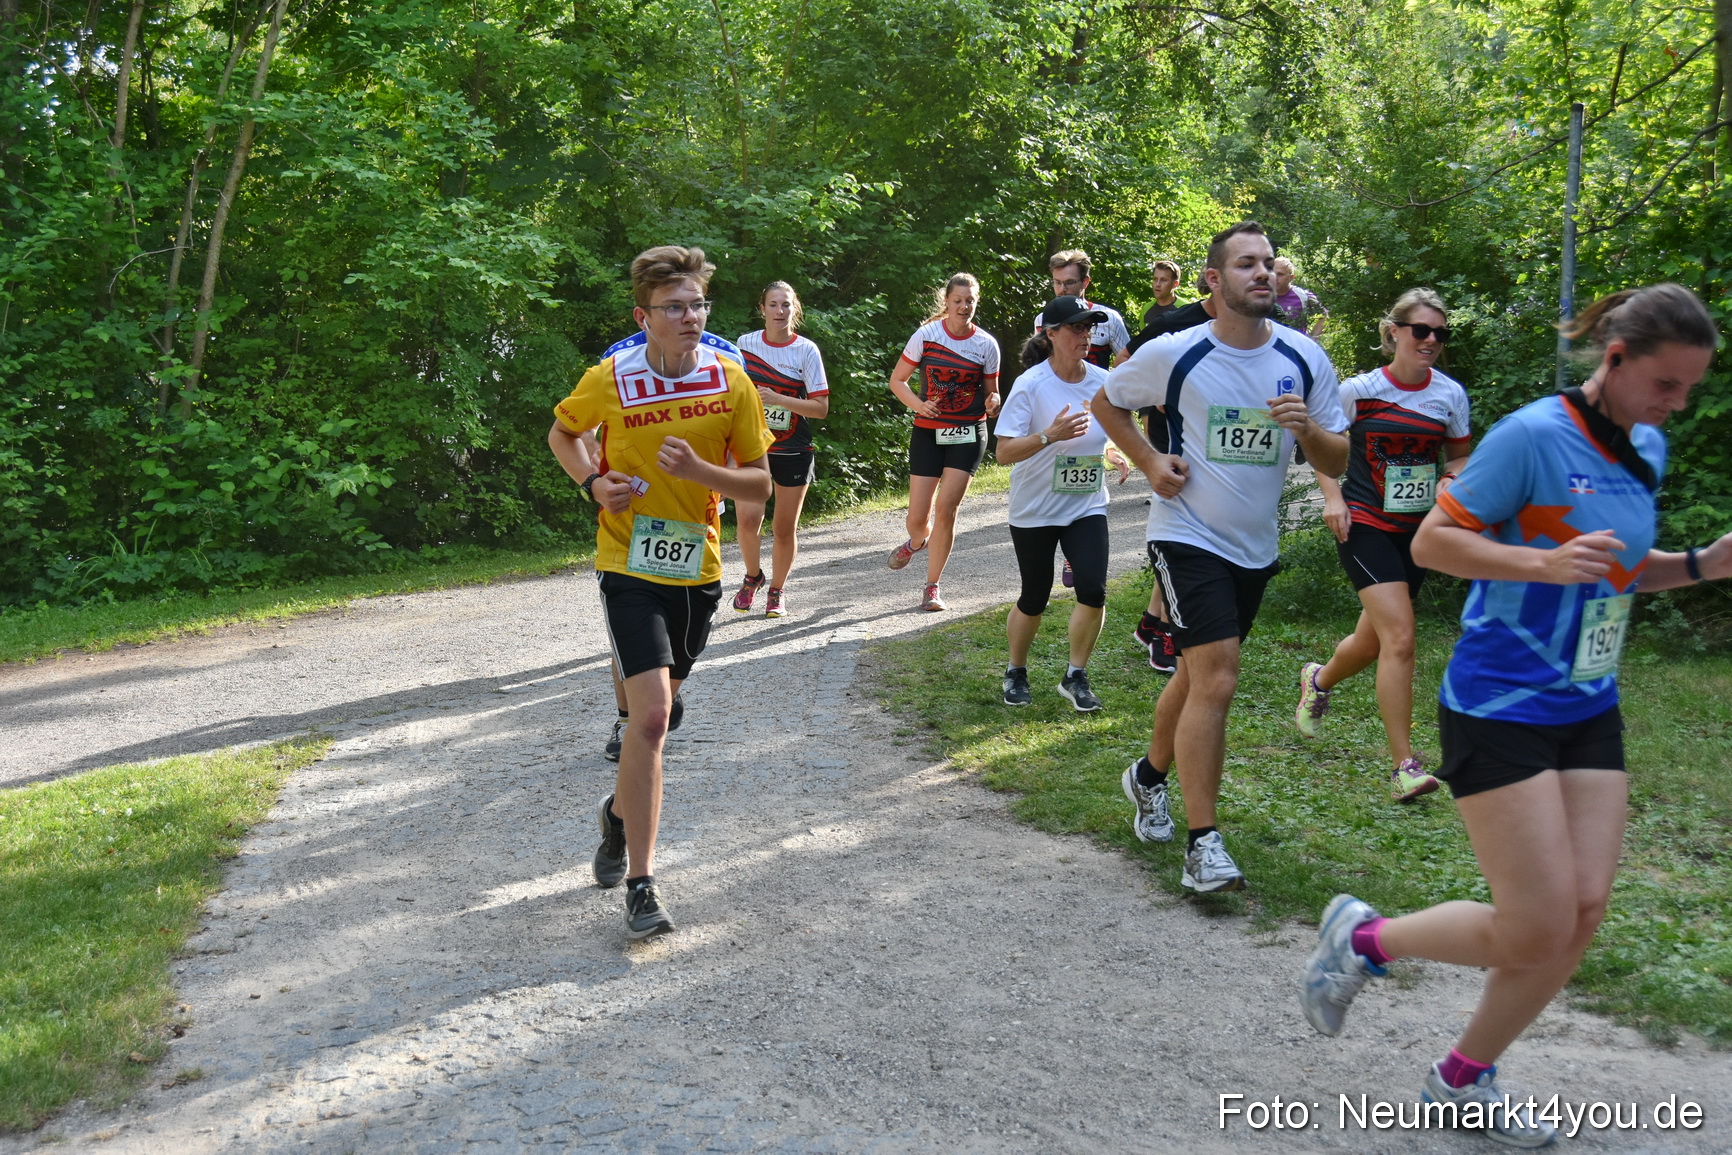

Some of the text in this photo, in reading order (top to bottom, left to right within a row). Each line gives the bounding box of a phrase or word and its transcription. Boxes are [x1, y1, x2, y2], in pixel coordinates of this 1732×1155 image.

[623, 400, 732, 428] MAX BÖGL
[941, 426, 970, 436] 2245
[1217, 427, 1272, 449] 1874
[1061, 469, 1097, 483] 1335
[1392, 481, 1430, 499] 2251
[641, 537, 696, 563] 1687
[646, 559, 686, 569] Spiegel Jonas
